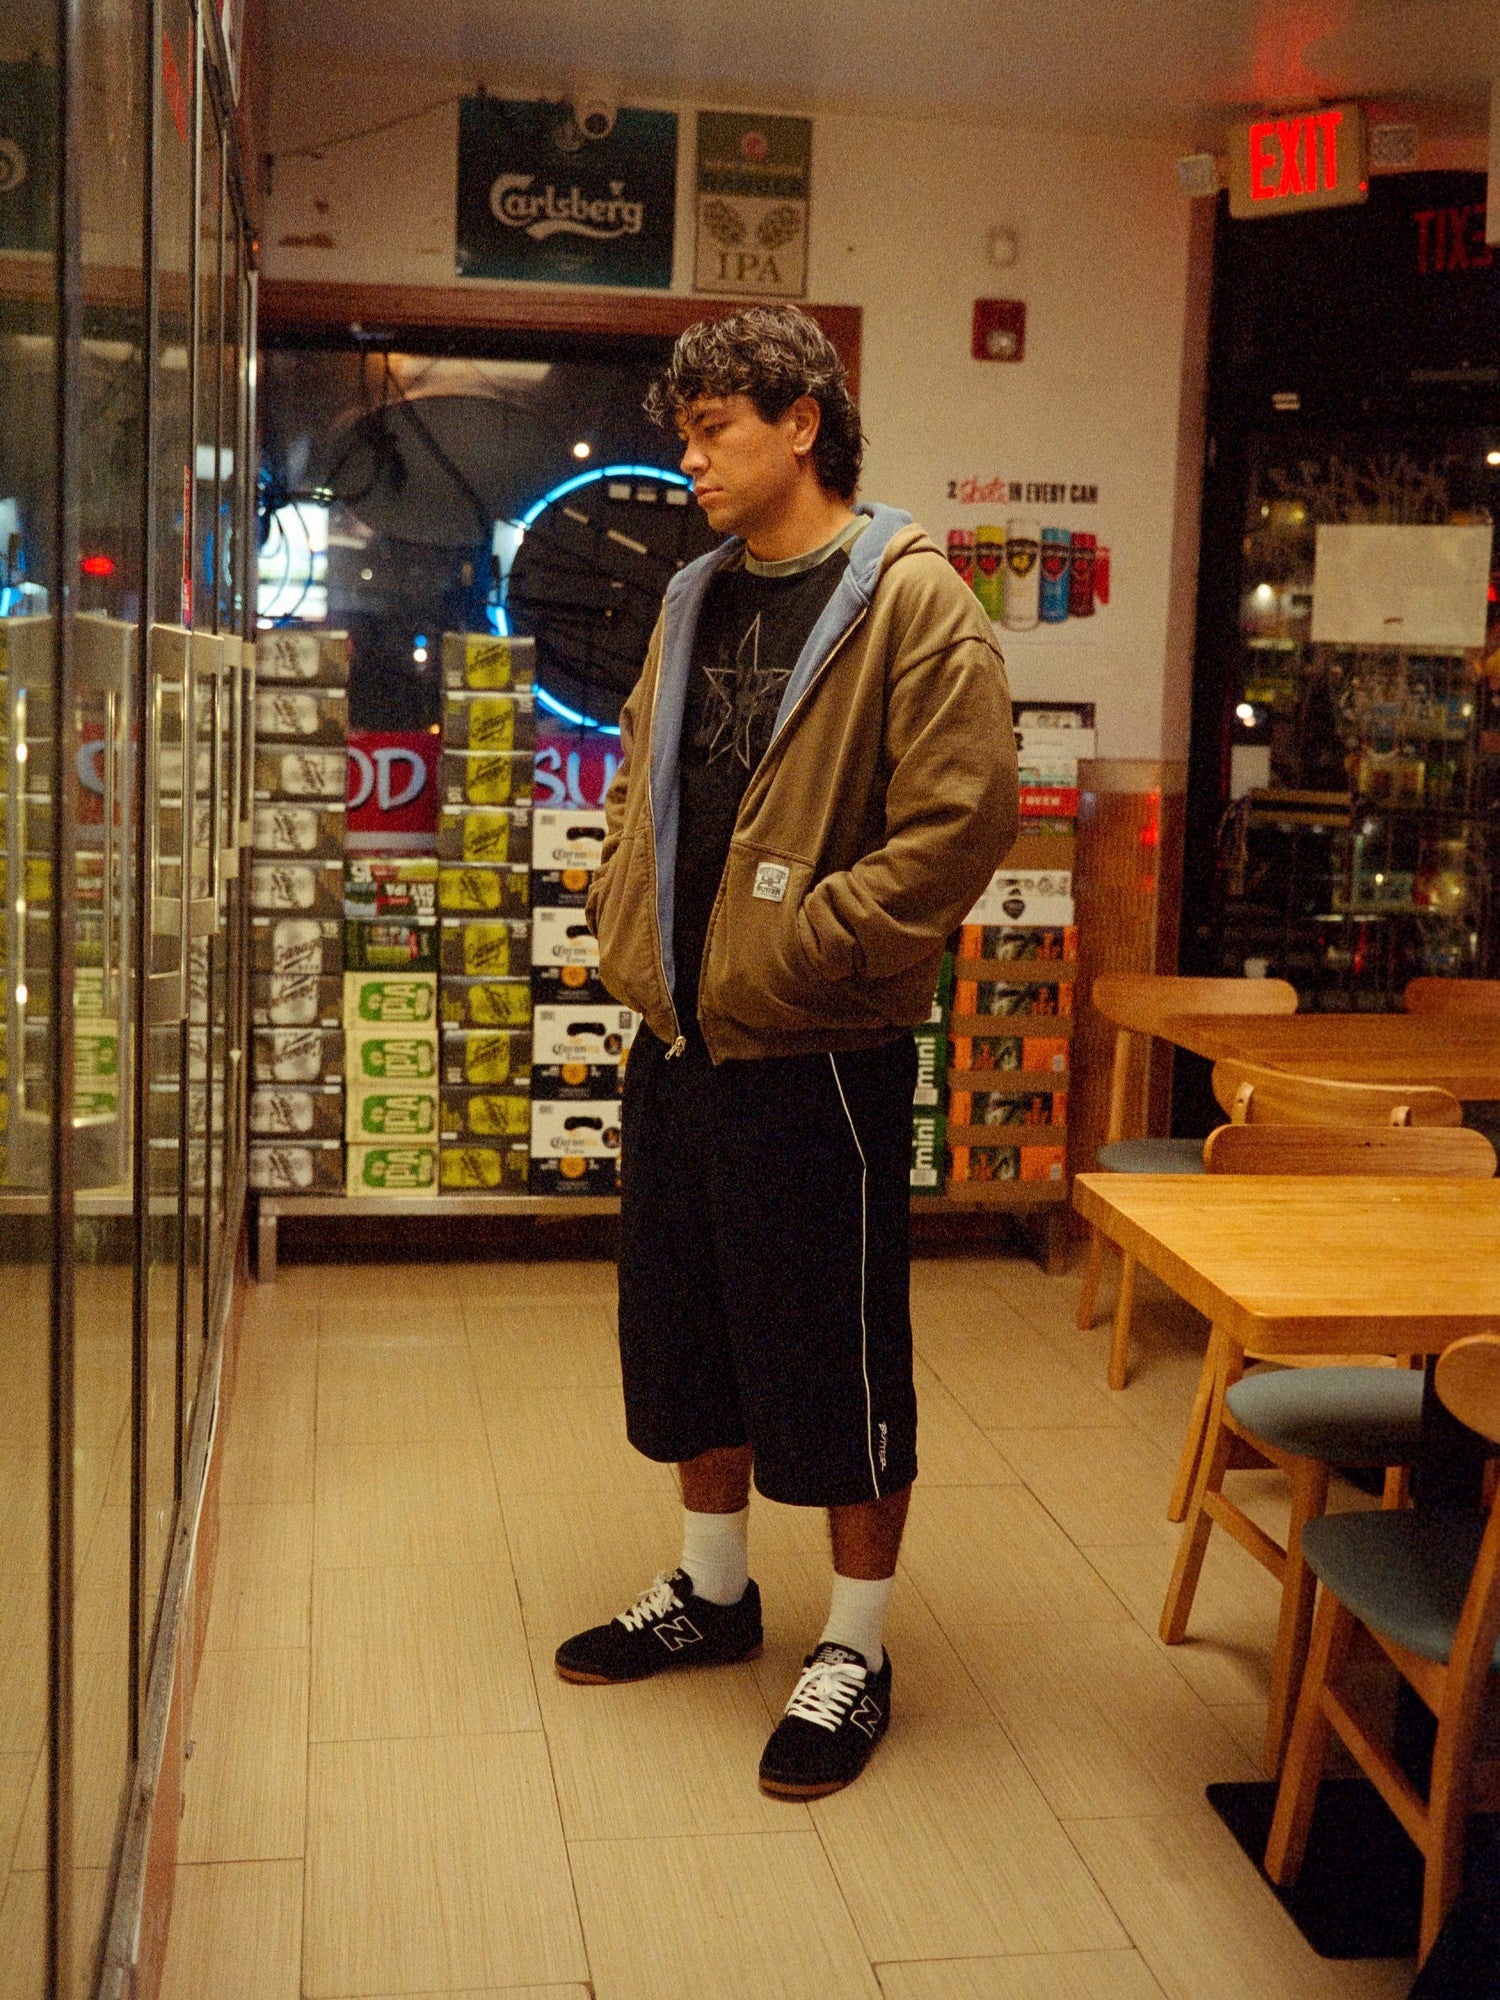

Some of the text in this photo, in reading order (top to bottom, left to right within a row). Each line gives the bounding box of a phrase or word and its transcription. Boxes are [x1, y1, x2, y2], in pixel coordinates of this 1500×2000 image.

[1250, 111, 1343, 200] EXIT
[489, 173, 645, 241] Carlsberg
[717, 252, 781, 283] IPA
[947, 481, 958, 499] 2
[1009, 481, 1022, 501] IN
[1026, 482, 1065, 502] EVERY
[1070, 483, 1098, 503] CAN
[382, 983, 416, 1021] IPA
[385, 1041, 418, 1078] IPA
[385, 1098, 418, 1134] IPA
[912, 1118, 935, 1169] mini
[386, 1153, 420, 1189] IPA
[653, 1616, 703, 1651] N
[850, 1695, 883, 1738] N
